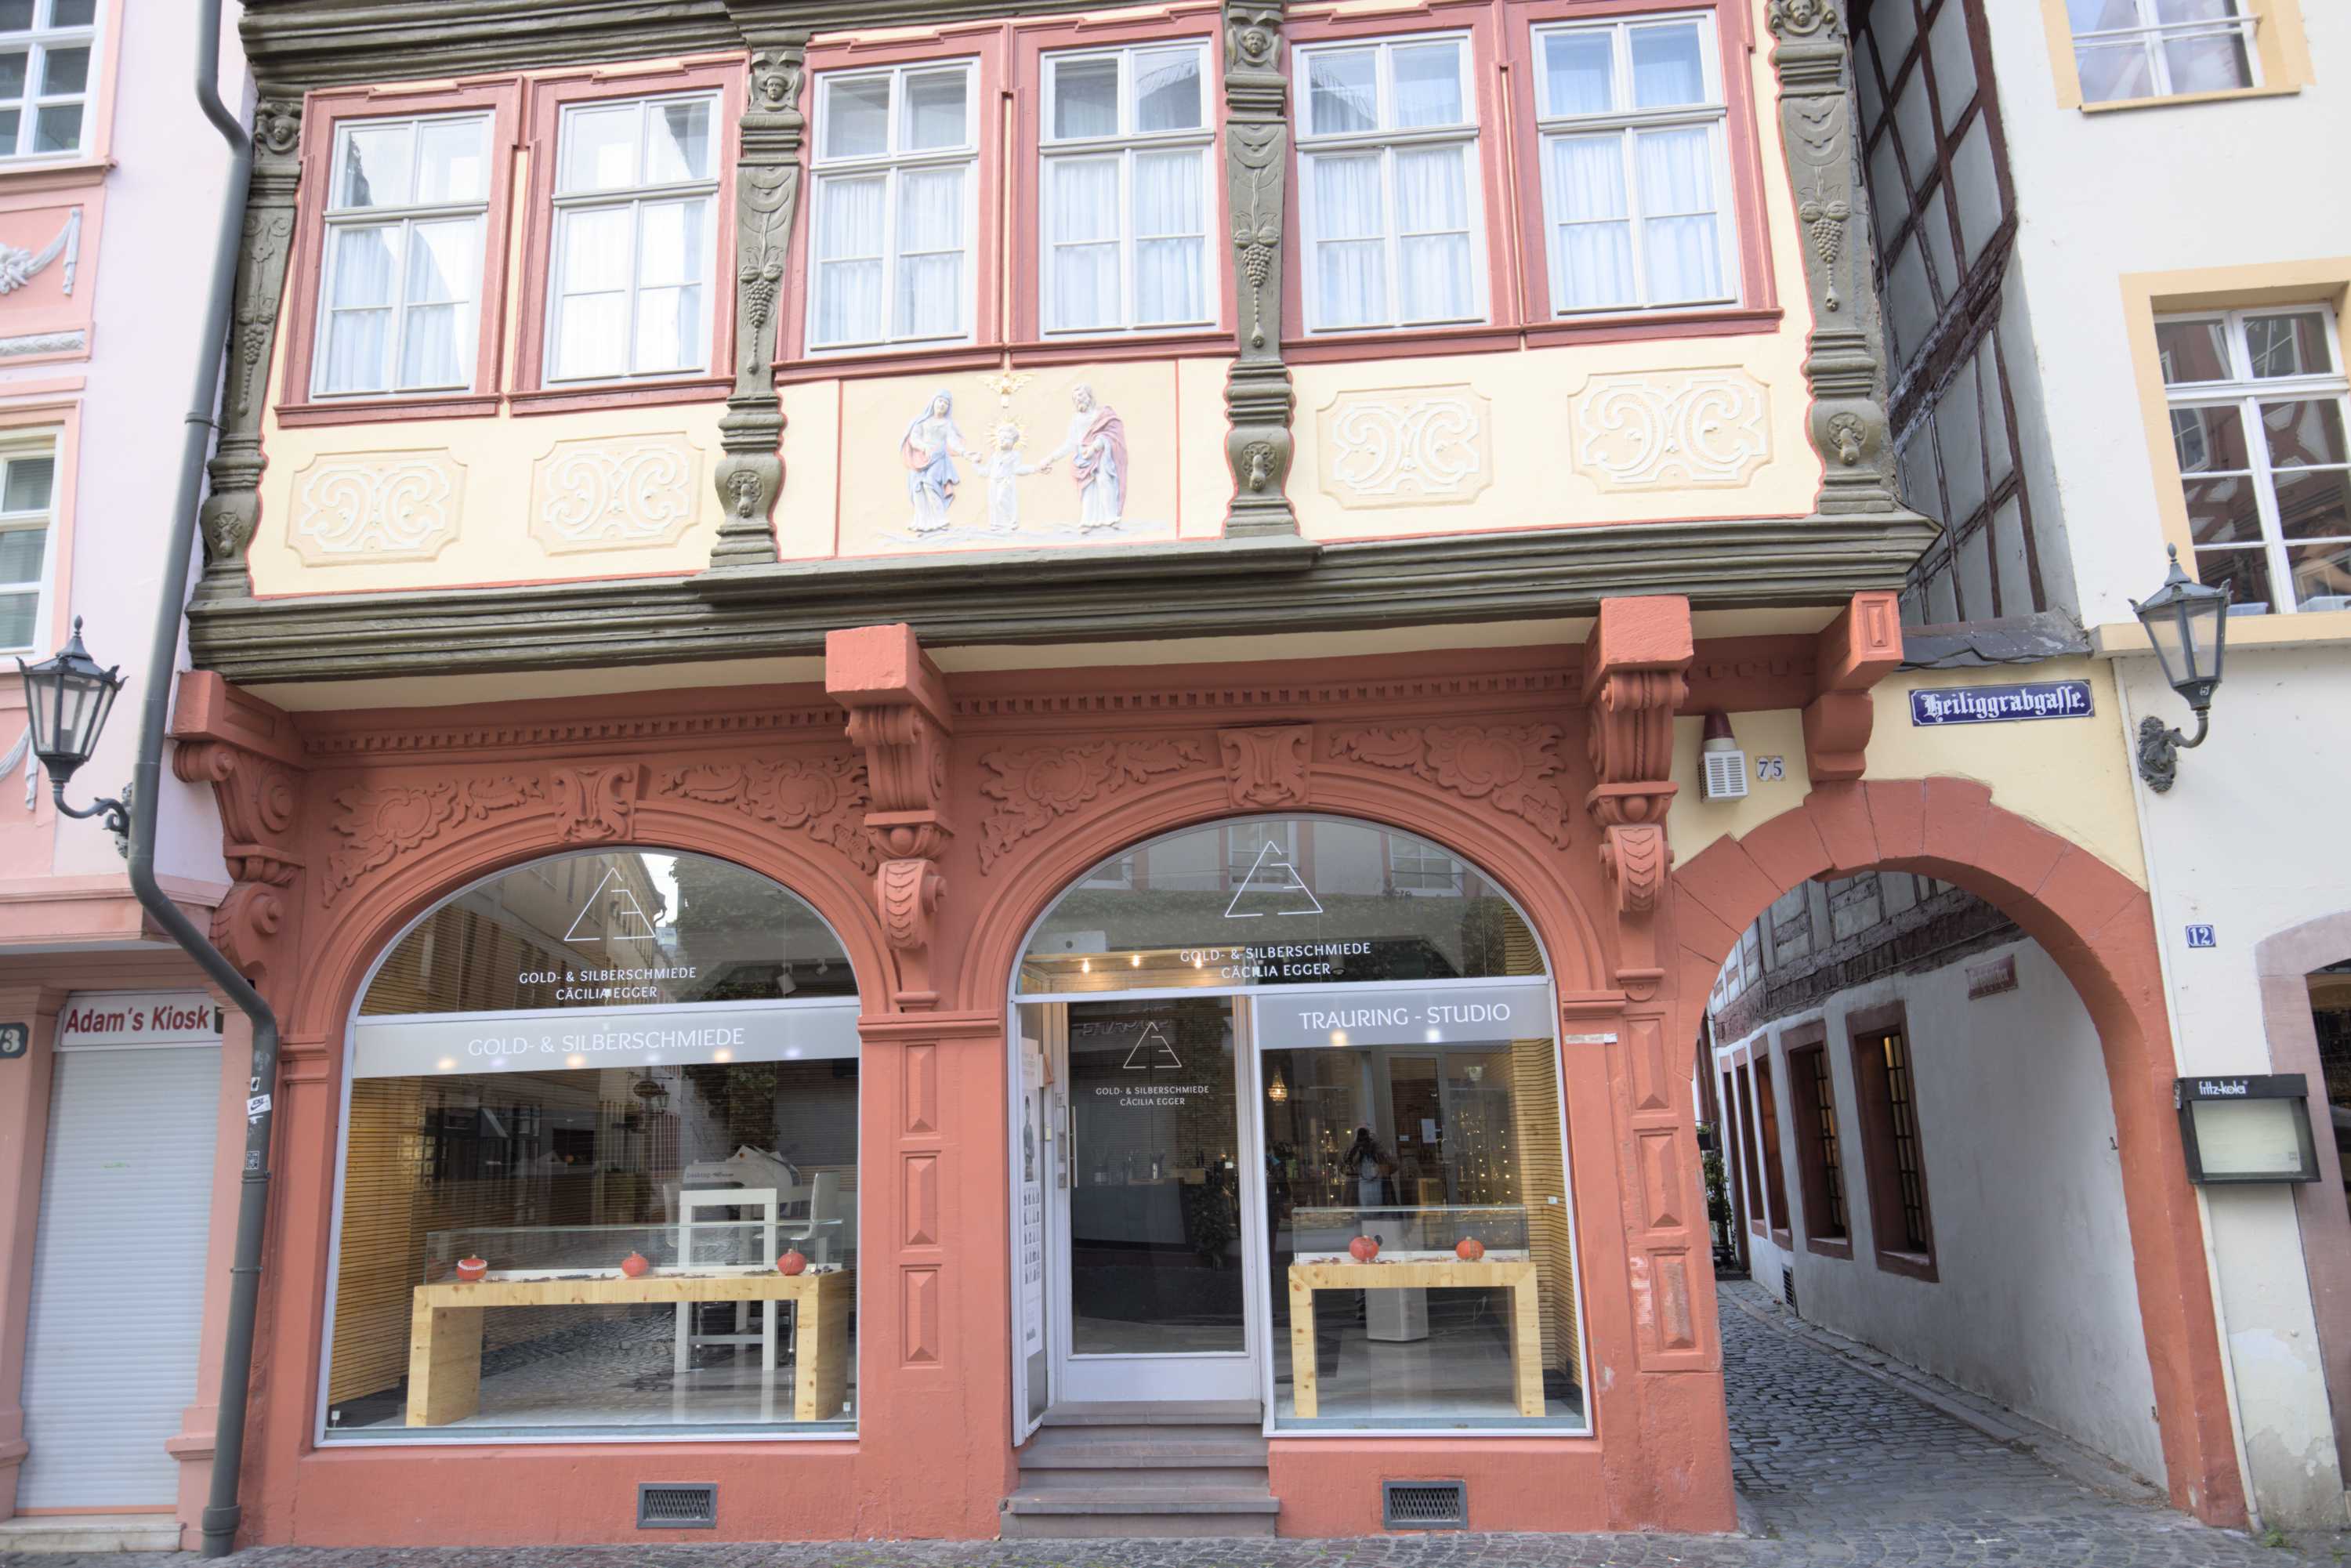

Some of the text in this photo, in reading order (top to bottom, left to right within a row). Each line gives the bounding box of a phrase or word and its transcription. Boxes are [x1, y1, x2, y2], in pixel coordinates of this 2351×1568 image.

[1759, 760, 1783, 777] 75
[2190, 927, 2212, 946] 12
[1180, 942, 1371, 962] GOLD- & SILBERSCHMIEDE
[519, 967, 697, 984] GOLD- & SILBERSCHMIEDE
[1221, 963, 1331, 979] CÄCILIA EGGER
[556, 986, 658, 1001] CÄCILIA EGGER
[64, 1005, 210, 1034] Adam's Kiosk
[1299, 1008, 1408, 1030] TRAURING
[1426, 1003, 1511, 1024] STUDIO
[468, 1027, 745, 1056] GOLD- & SILBERSCHMIEDE
[1134, 1085, 1209, 1095] SILBERSCHMIEDE
[1157, 1097, 1186, 1106] EGGER
